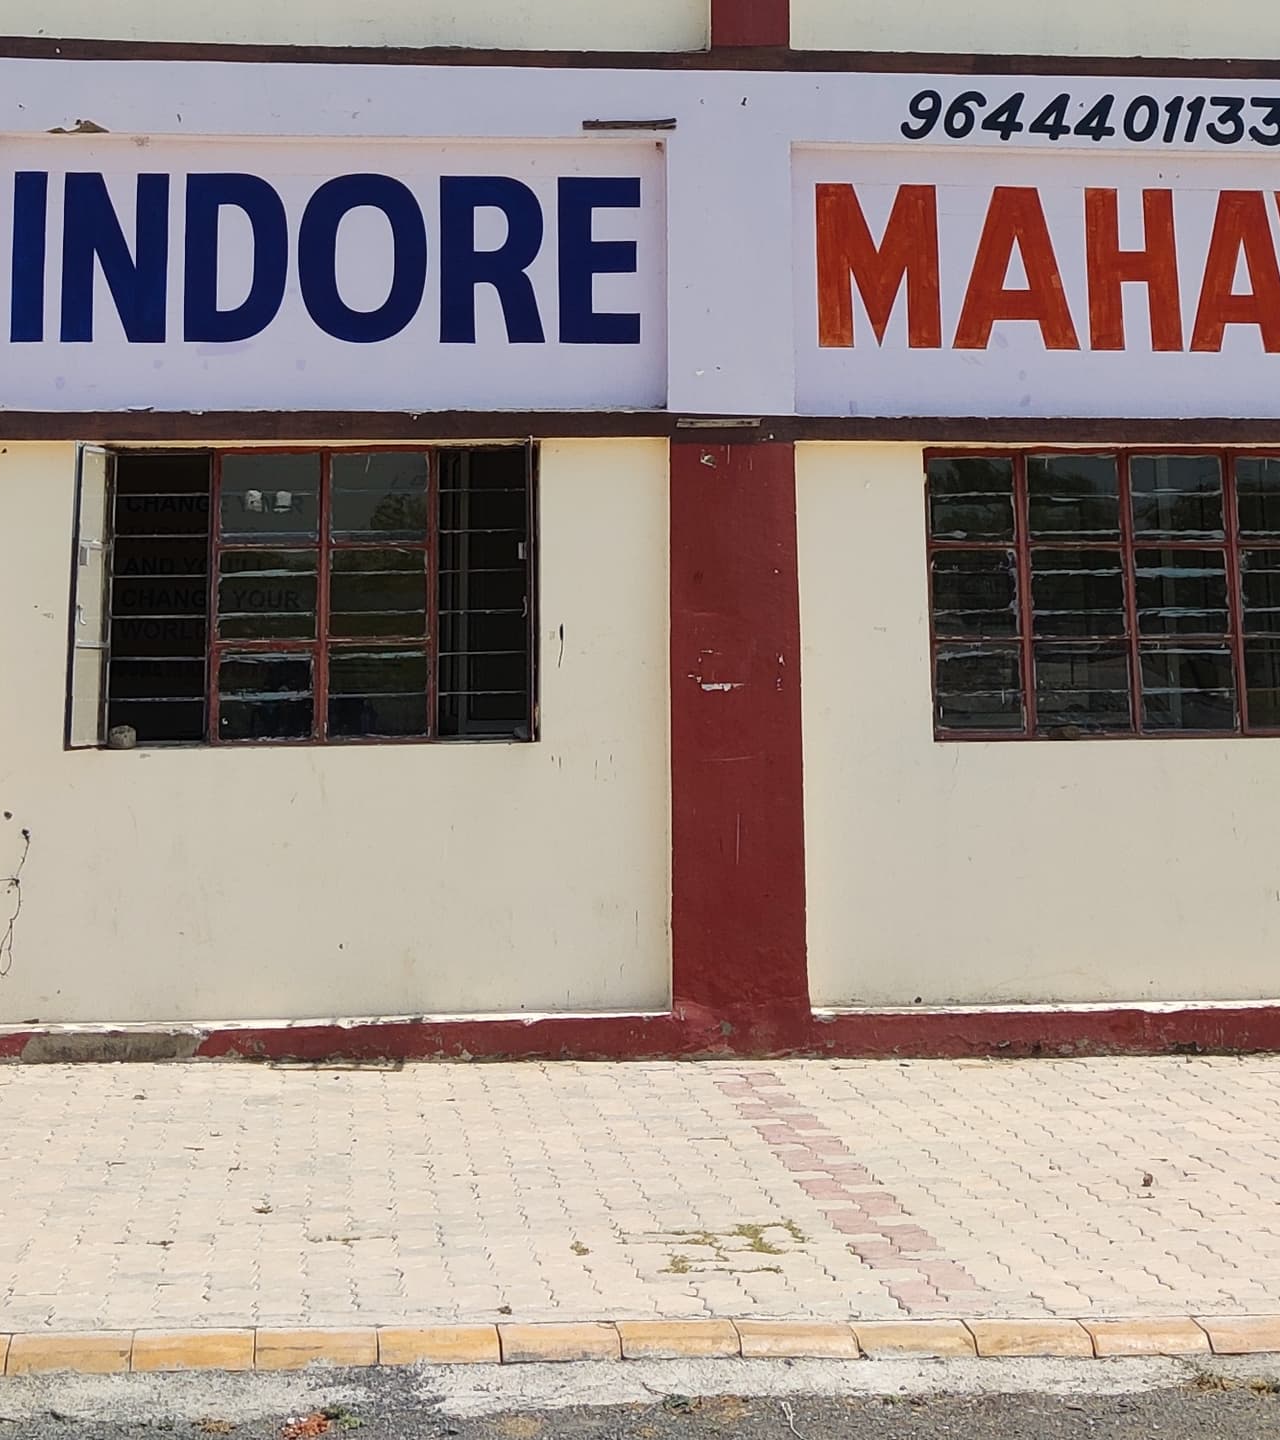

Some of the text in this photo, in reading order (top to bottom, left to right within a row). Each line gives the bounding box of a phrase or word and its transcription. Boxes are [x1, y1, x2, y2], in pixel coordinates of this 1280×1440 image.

[10, 170, 641, 345] INDORE
[121, 589, 301, 610] CHANG YOUR
